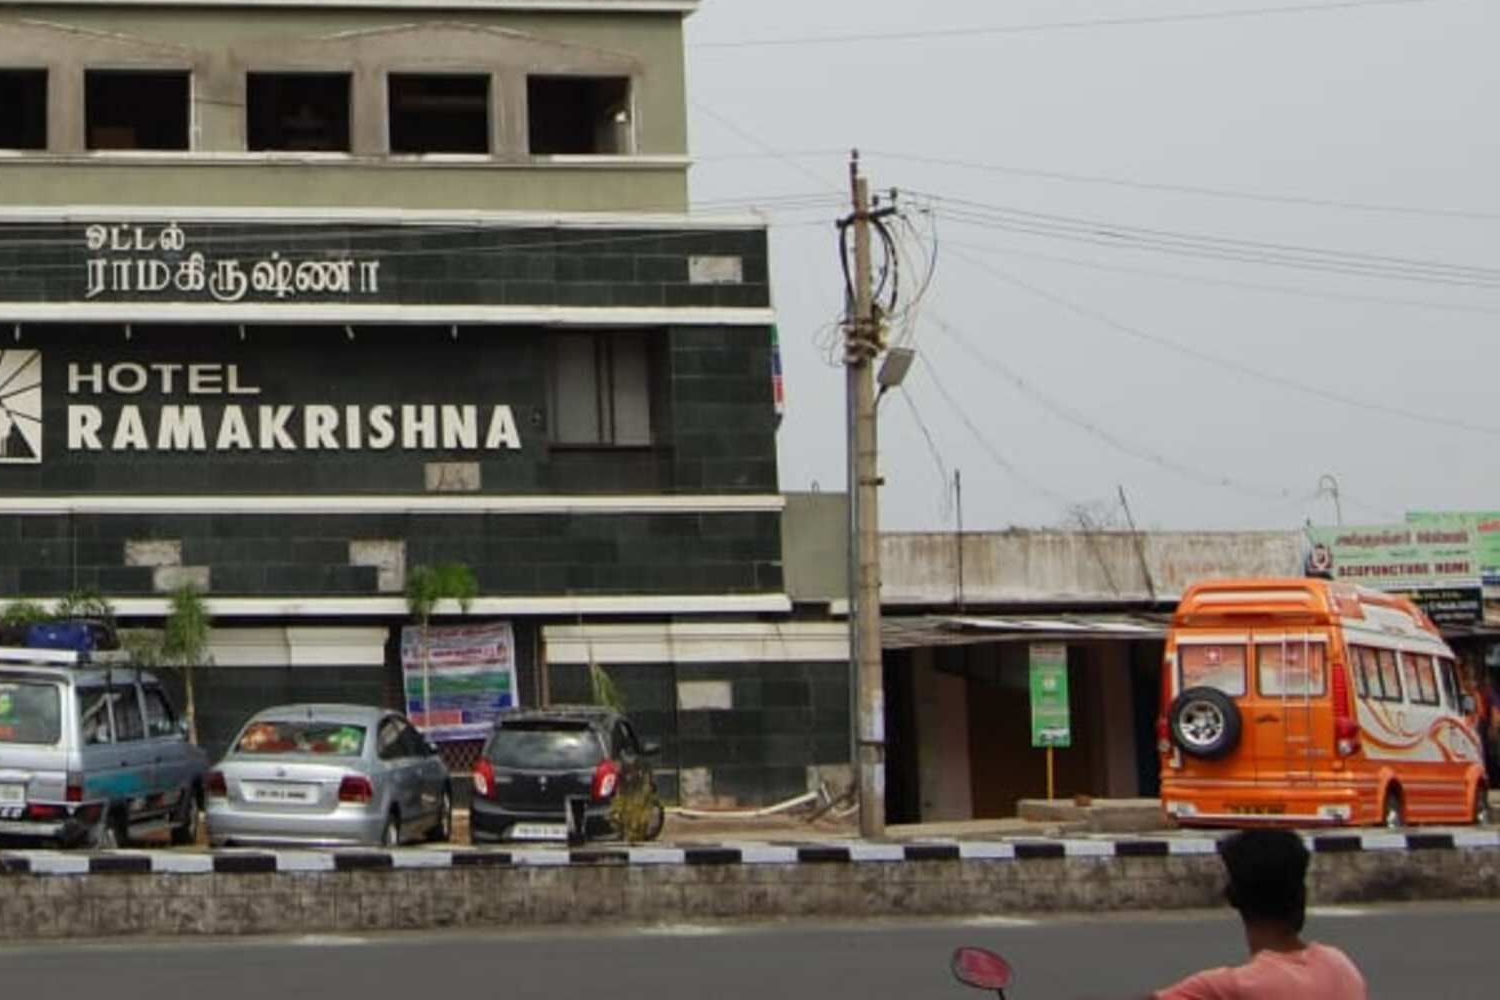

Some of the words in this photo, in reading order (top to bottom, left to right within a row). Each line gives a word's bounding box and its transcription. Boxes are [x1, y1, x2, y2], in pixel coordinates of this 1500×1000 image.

[84, 251, 380, 301] ராமகிருஷ்ணா
[67, 363, 261, 394] HOTEL
[66, 403, 523, 450] RAMAKRISHNA
